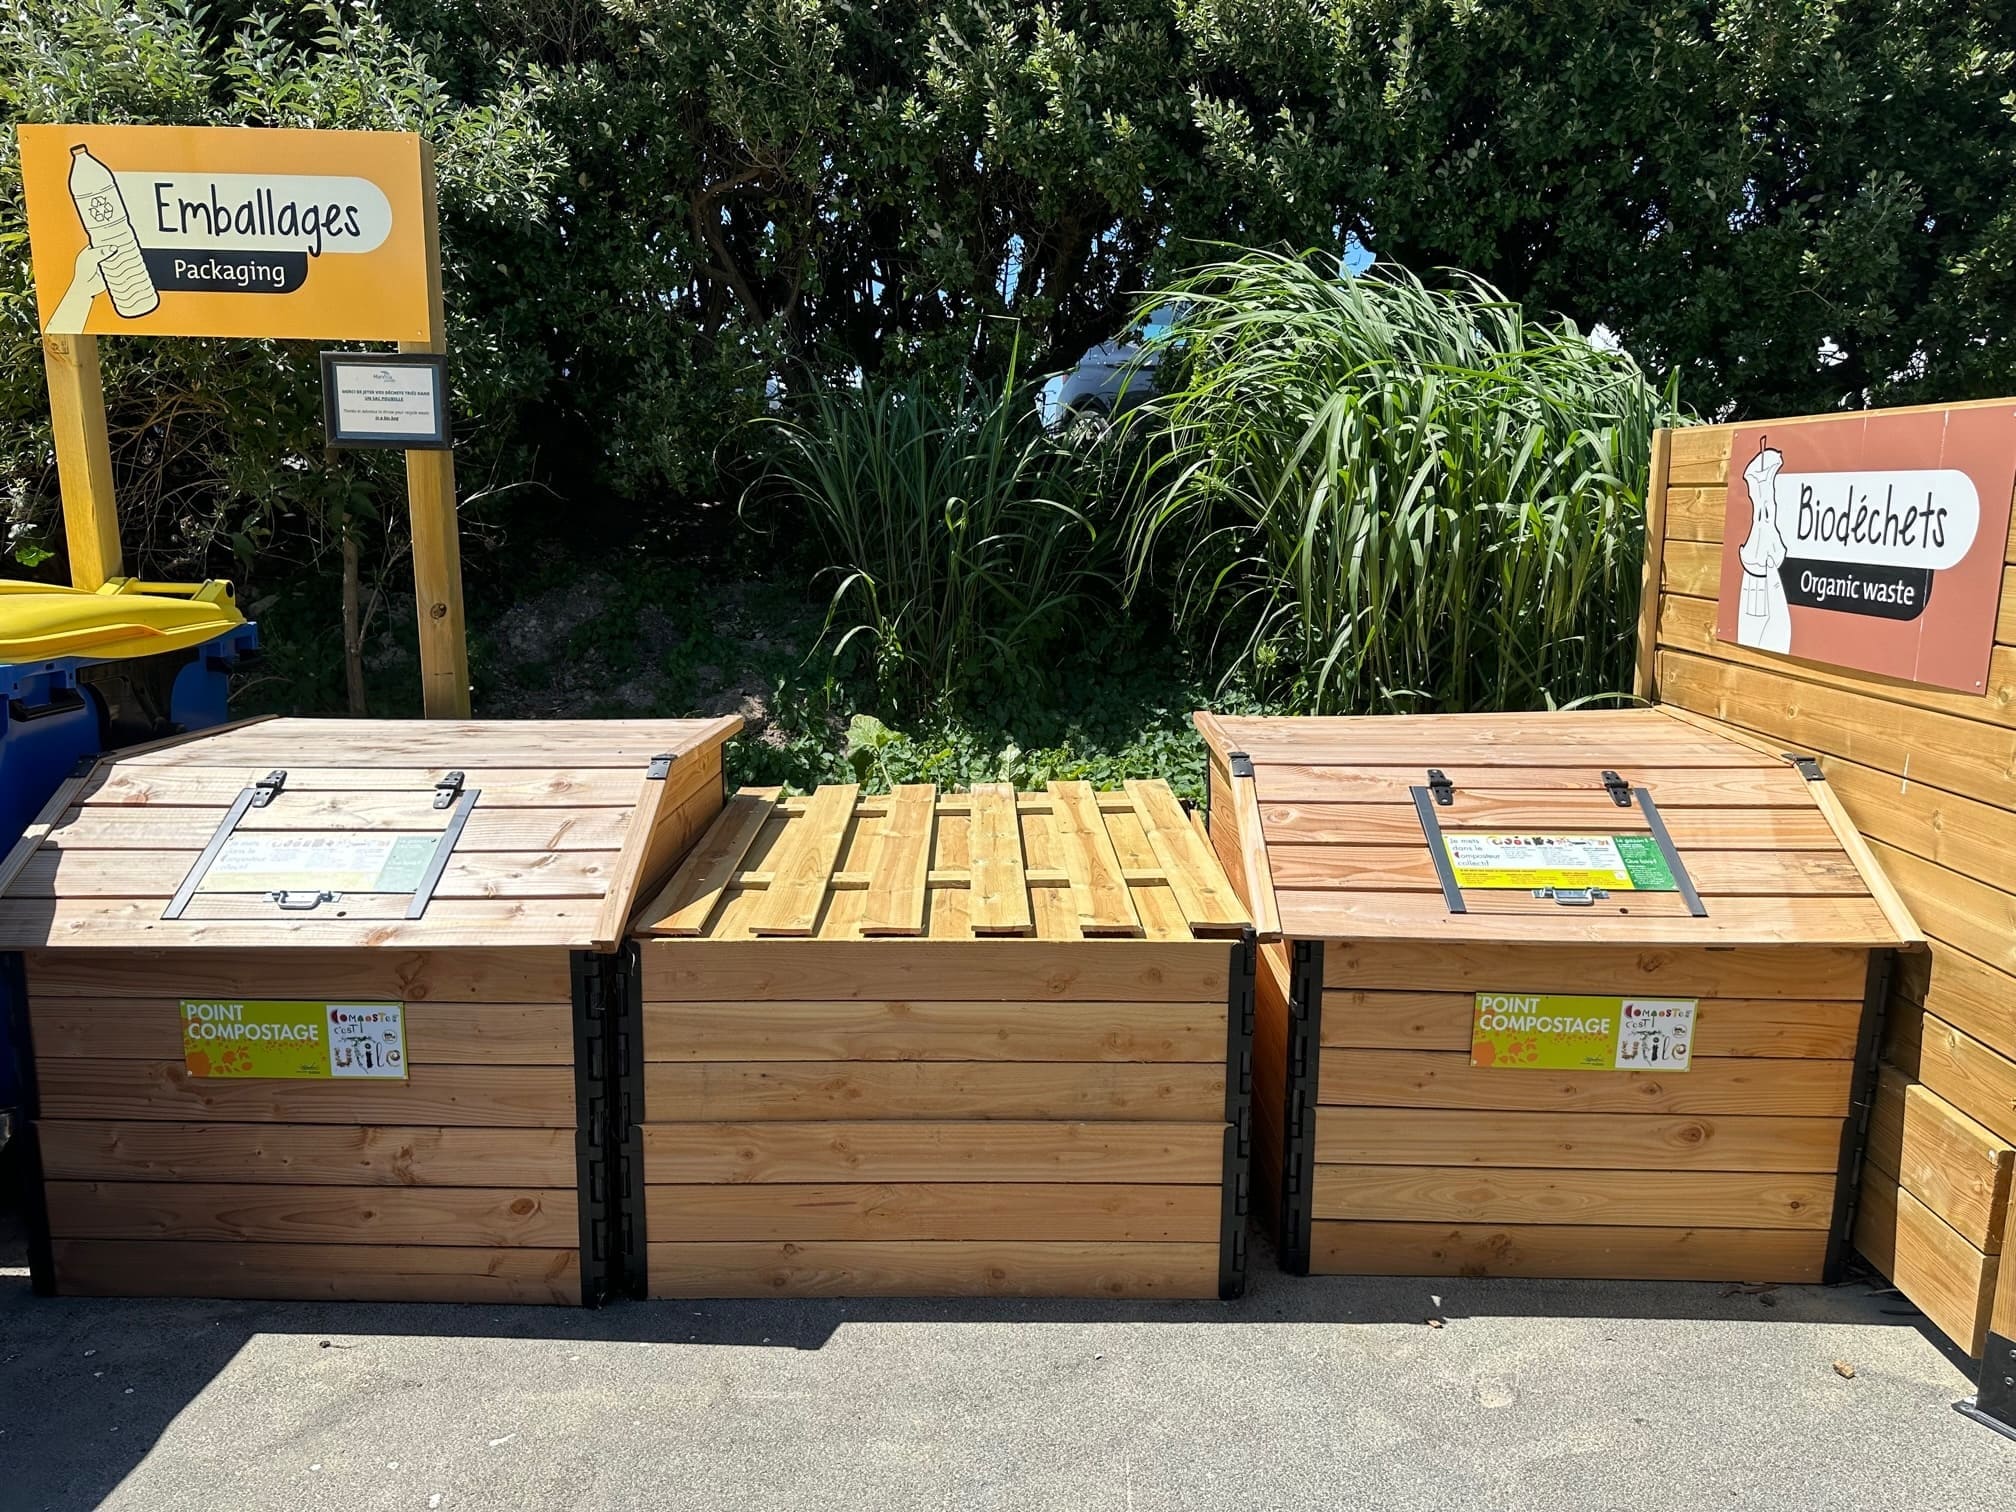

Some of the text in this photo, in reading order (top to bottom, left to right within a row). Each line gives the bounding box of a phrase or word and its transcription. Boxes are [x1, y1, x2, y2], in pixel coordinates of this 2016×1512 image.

[154, 182, 361, 257] Emballages
[175, 259, 285, 288] Packaging
[1797, 482, 1949, 549] Biodéchets
[1800, 570, 1915, 606] Organic waste
[186, 1003, 244, 1021] POINT
[1481, 996, 1540, 1014] POINT
[187, 1022, 319, 1041] COMPOSTAGE
[1479, 1014, 1611, 1034] COMPOSTAGE
